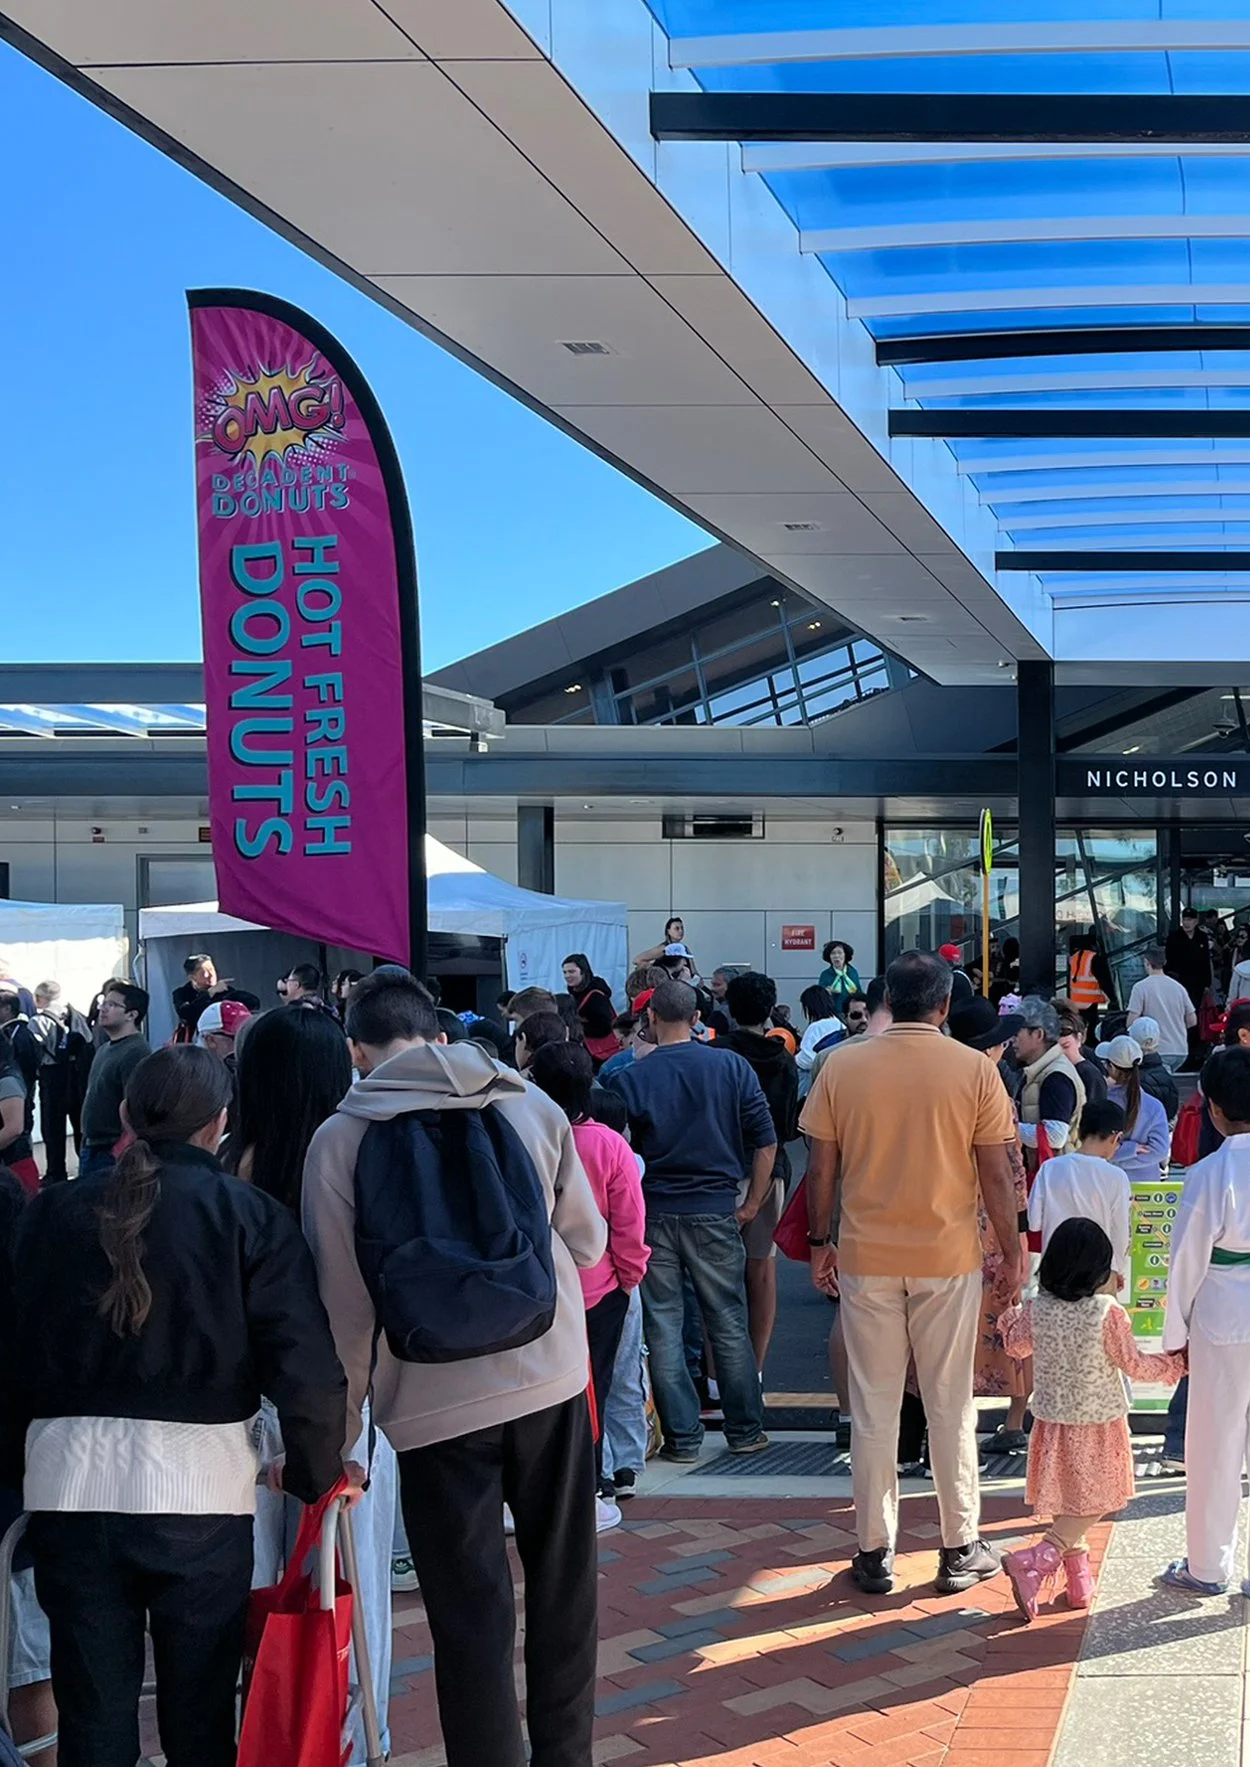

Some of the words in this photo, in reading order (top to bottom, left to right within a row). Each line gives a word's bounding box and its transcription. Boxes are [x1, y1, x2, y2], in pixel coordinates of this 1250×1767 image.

[213, 379, 346, 455] OMG!
[211, 483, 350, 518] DONUTS
[212, 463, 350, 493] DECADENT
[292, 535, 343, 659] HOT
[227, 539, 295, 861] DONUTS
[301, 672, 353, 857] FRESH
[1087, 771, 1237, 788] NICHOLSON
